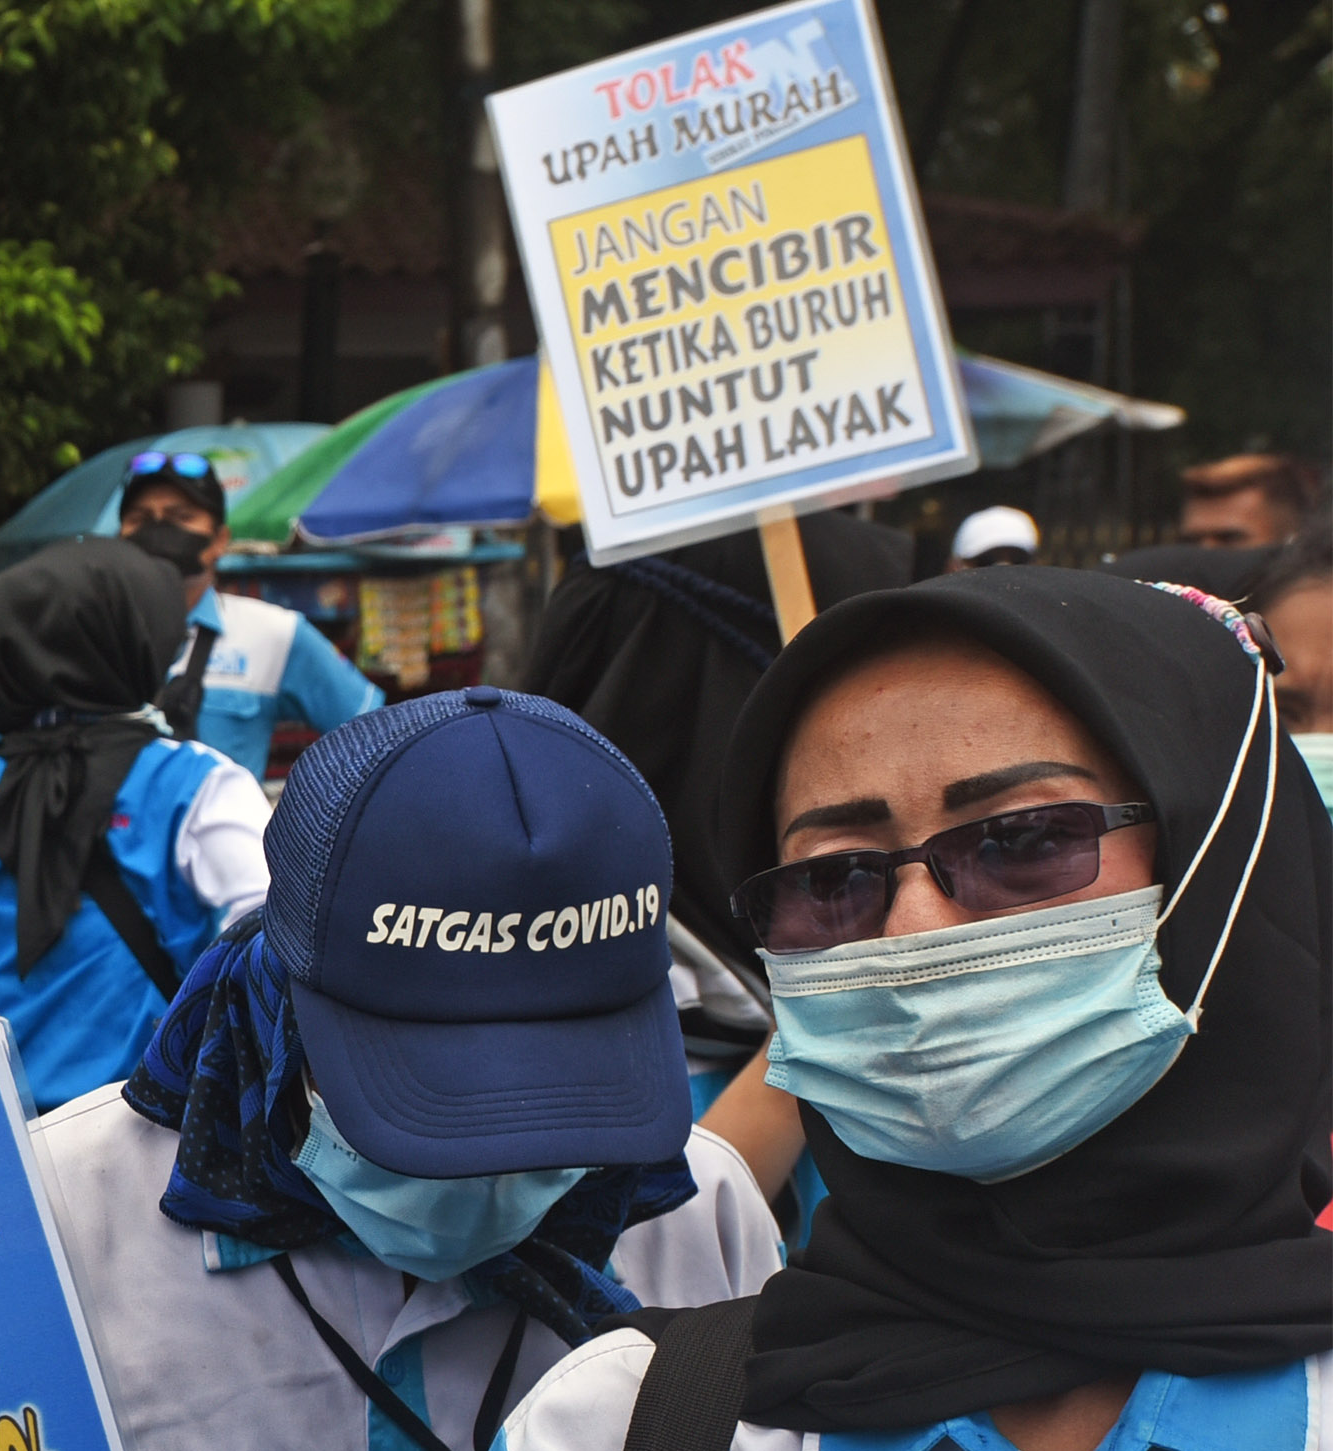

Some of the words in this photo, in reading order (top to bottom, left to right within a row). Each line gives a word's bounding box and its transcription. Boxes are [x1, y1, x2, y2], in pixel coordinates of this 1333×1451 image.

[541, 125, 660, 186] UPAH
[673, 71, 844, 153] MURAH
[595, 38, 756, 122] TOLAK
[573, 181, 769, 276] JANGAN
[582, 213, 879, 336] MENCIBIR
[591, 313, 739, 394] KETIKA
[744, 271, 892, 351] BURUH
[600, 350, 819, 446] NUNTUT
[613, 423, 746, 498] UPAH
[759, 382, 913, 464] LAYAK
[366, 903, 522, 953] SATGAS
[527, 883, 660, 952] COVID.19
